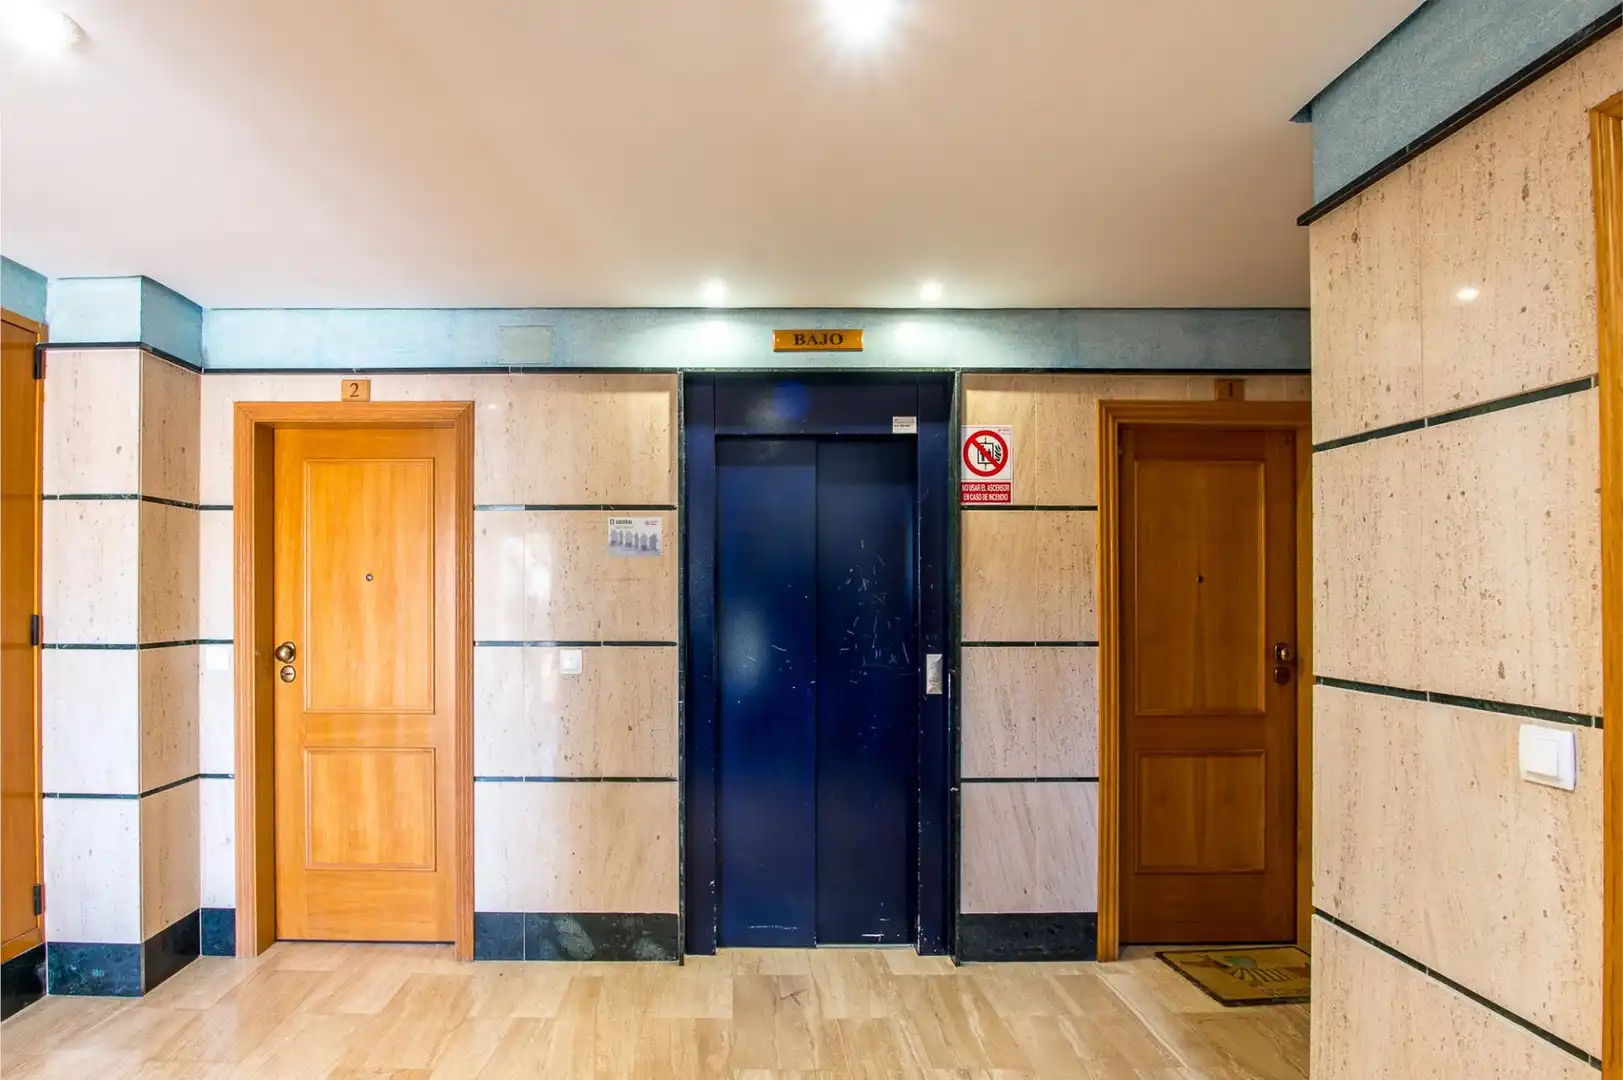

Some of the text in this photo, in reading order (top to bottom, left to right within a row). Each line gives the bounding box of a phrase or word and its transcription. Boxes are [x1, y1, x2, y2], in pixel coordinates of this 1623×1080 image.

[793, 333, 844, 346] BAJO
[349, 382, 360, 398] 2
[962, 483, 968, 491] NO
[969, 483, 981, 491] USAR
[987, 483, 1010, 491] ASCENSOR
[963, 493, 1008, 501] EN CASO DE INCENDIO
